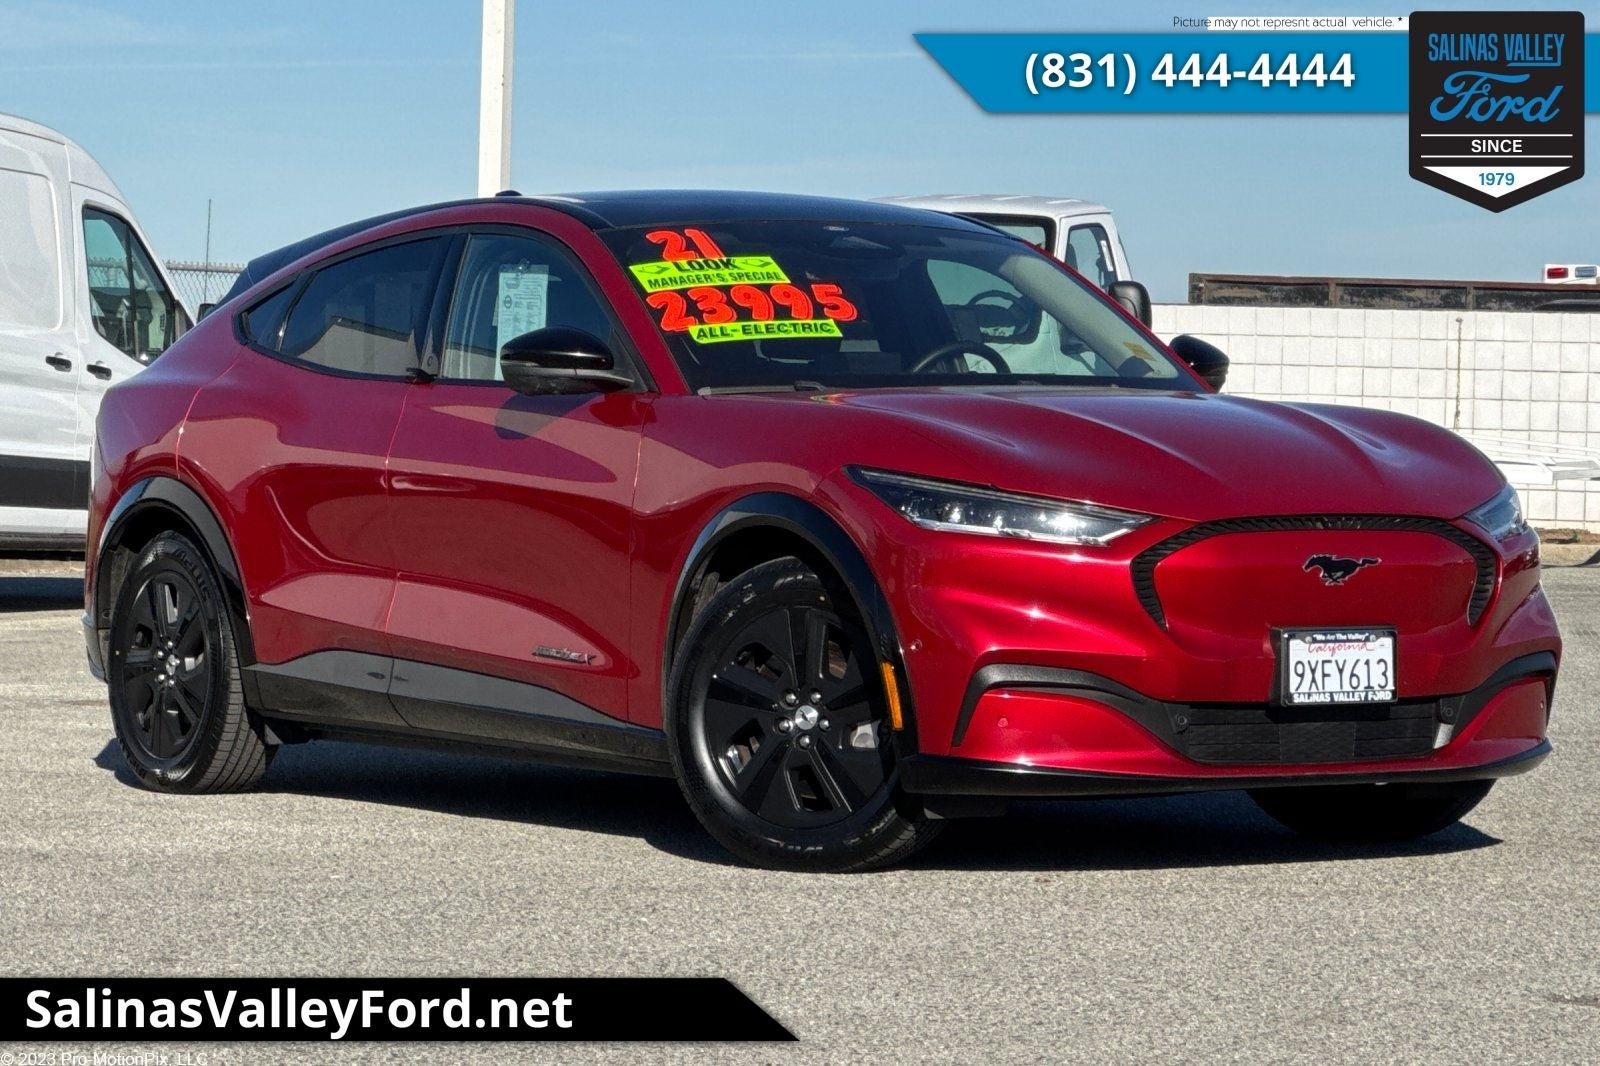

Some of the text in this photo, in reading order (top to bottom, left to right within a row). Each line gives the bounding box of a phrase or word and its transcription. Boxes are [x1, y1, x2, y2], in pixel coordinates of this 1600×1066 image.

[645, 228, 726, 262] 21
[672, 256, 741, 273] LOOK
[647, 271, 782, 290] MANAGER'S SPECIAL
[645, 284, 858, 333] 23995
[696, 322, 836, 340] ALL-ELECTRIC
[1307, 641, 1376, 657] California
[1294, 658, 1388, 691] 9XFY613
[1293, 690, 1393, 703] SALINAS VALLEY FORD
